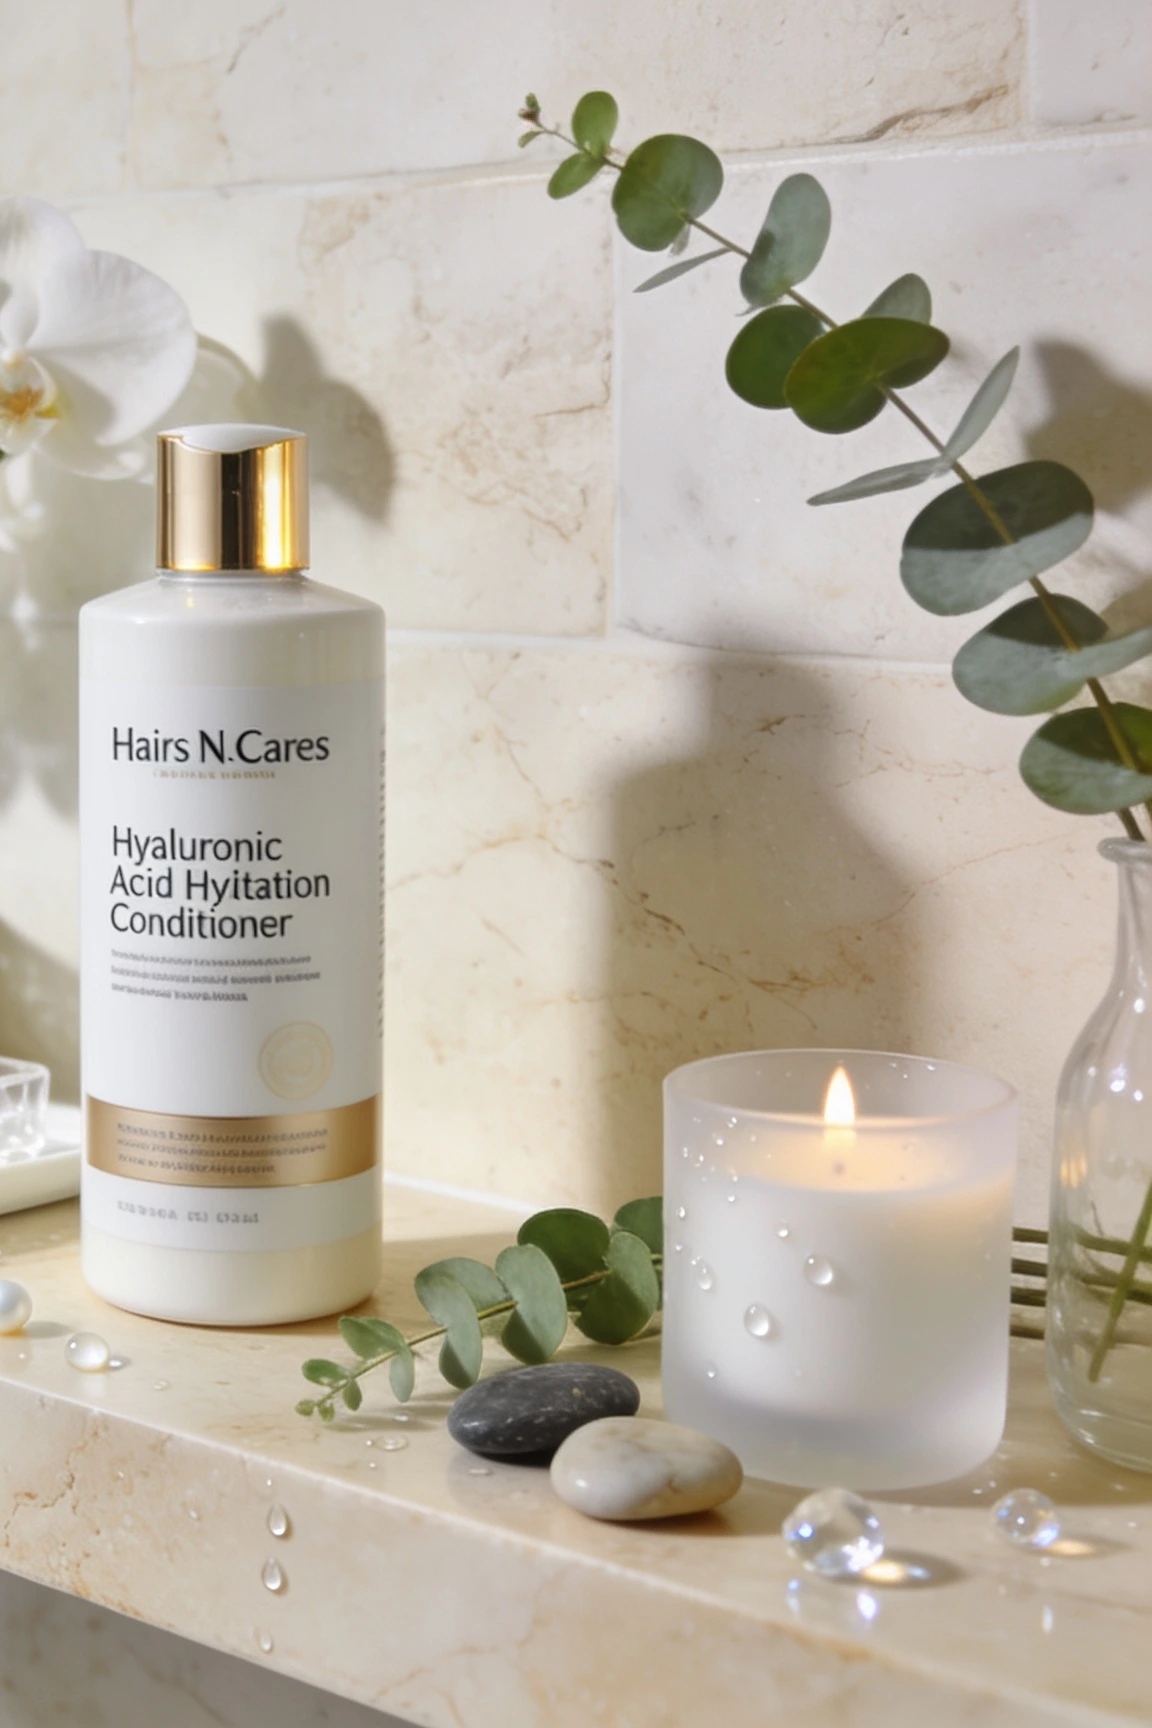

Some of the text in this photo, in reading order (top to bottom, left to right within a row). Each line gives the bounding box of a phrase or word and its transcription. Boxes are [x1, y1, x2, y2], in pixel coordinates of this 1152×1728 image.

[112, 726, 190, 763] Hairs
[112, 825, 283, 867] Hyaluronic
[110, 865, 330, 907] Acid Hyitation
[110, 902, 294, 940] Conditioner
